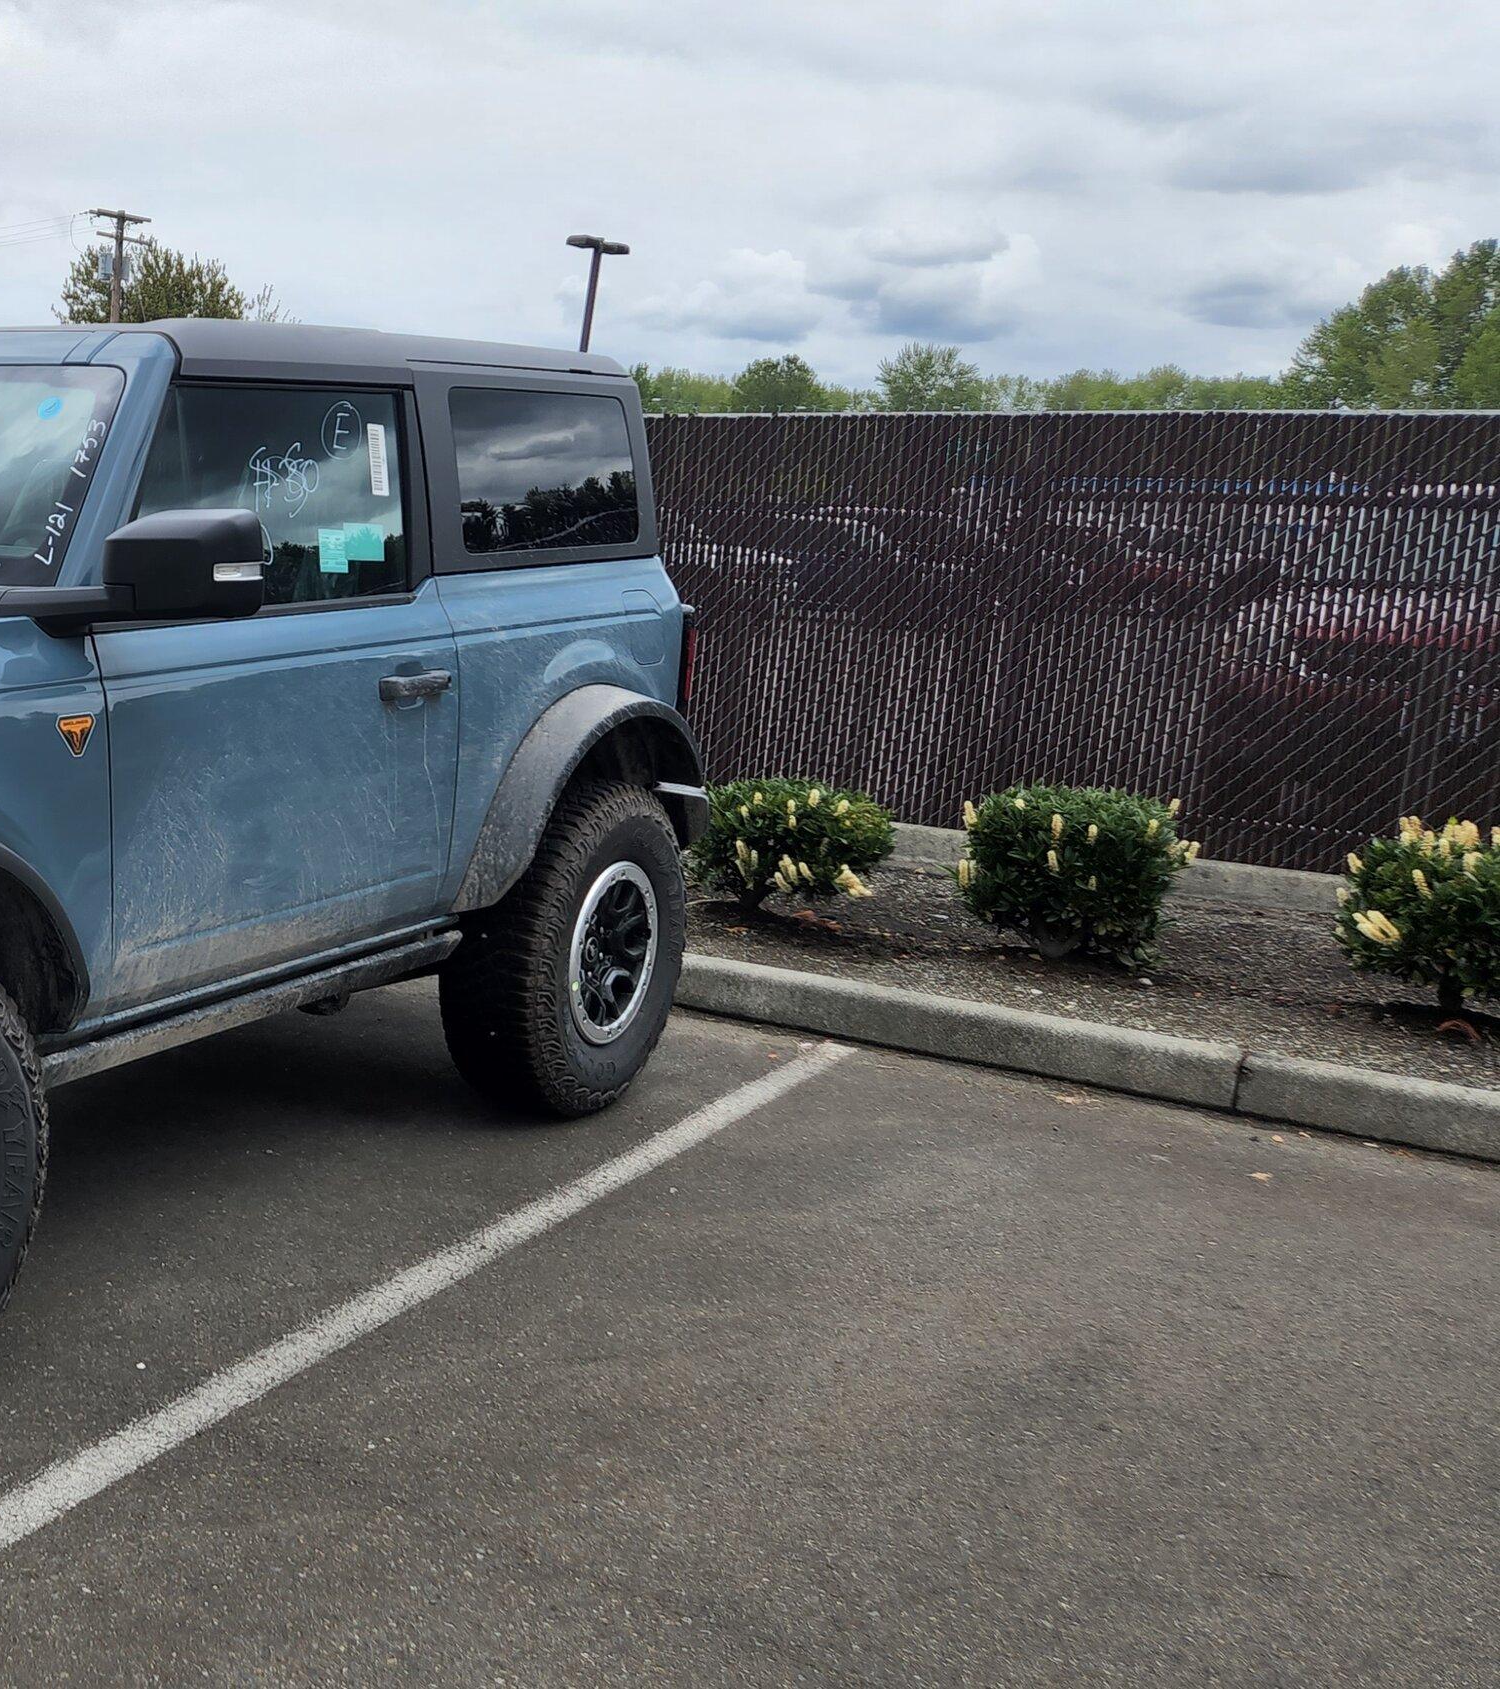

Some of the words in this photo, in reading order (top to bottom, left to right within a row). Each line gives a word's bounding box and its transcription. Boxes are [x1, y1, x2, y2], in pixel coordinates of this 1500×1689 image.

[333, 412, 350, 450] E
[34, 502, 73, 564] L-121
[70, 419, 106, 477] 1753
